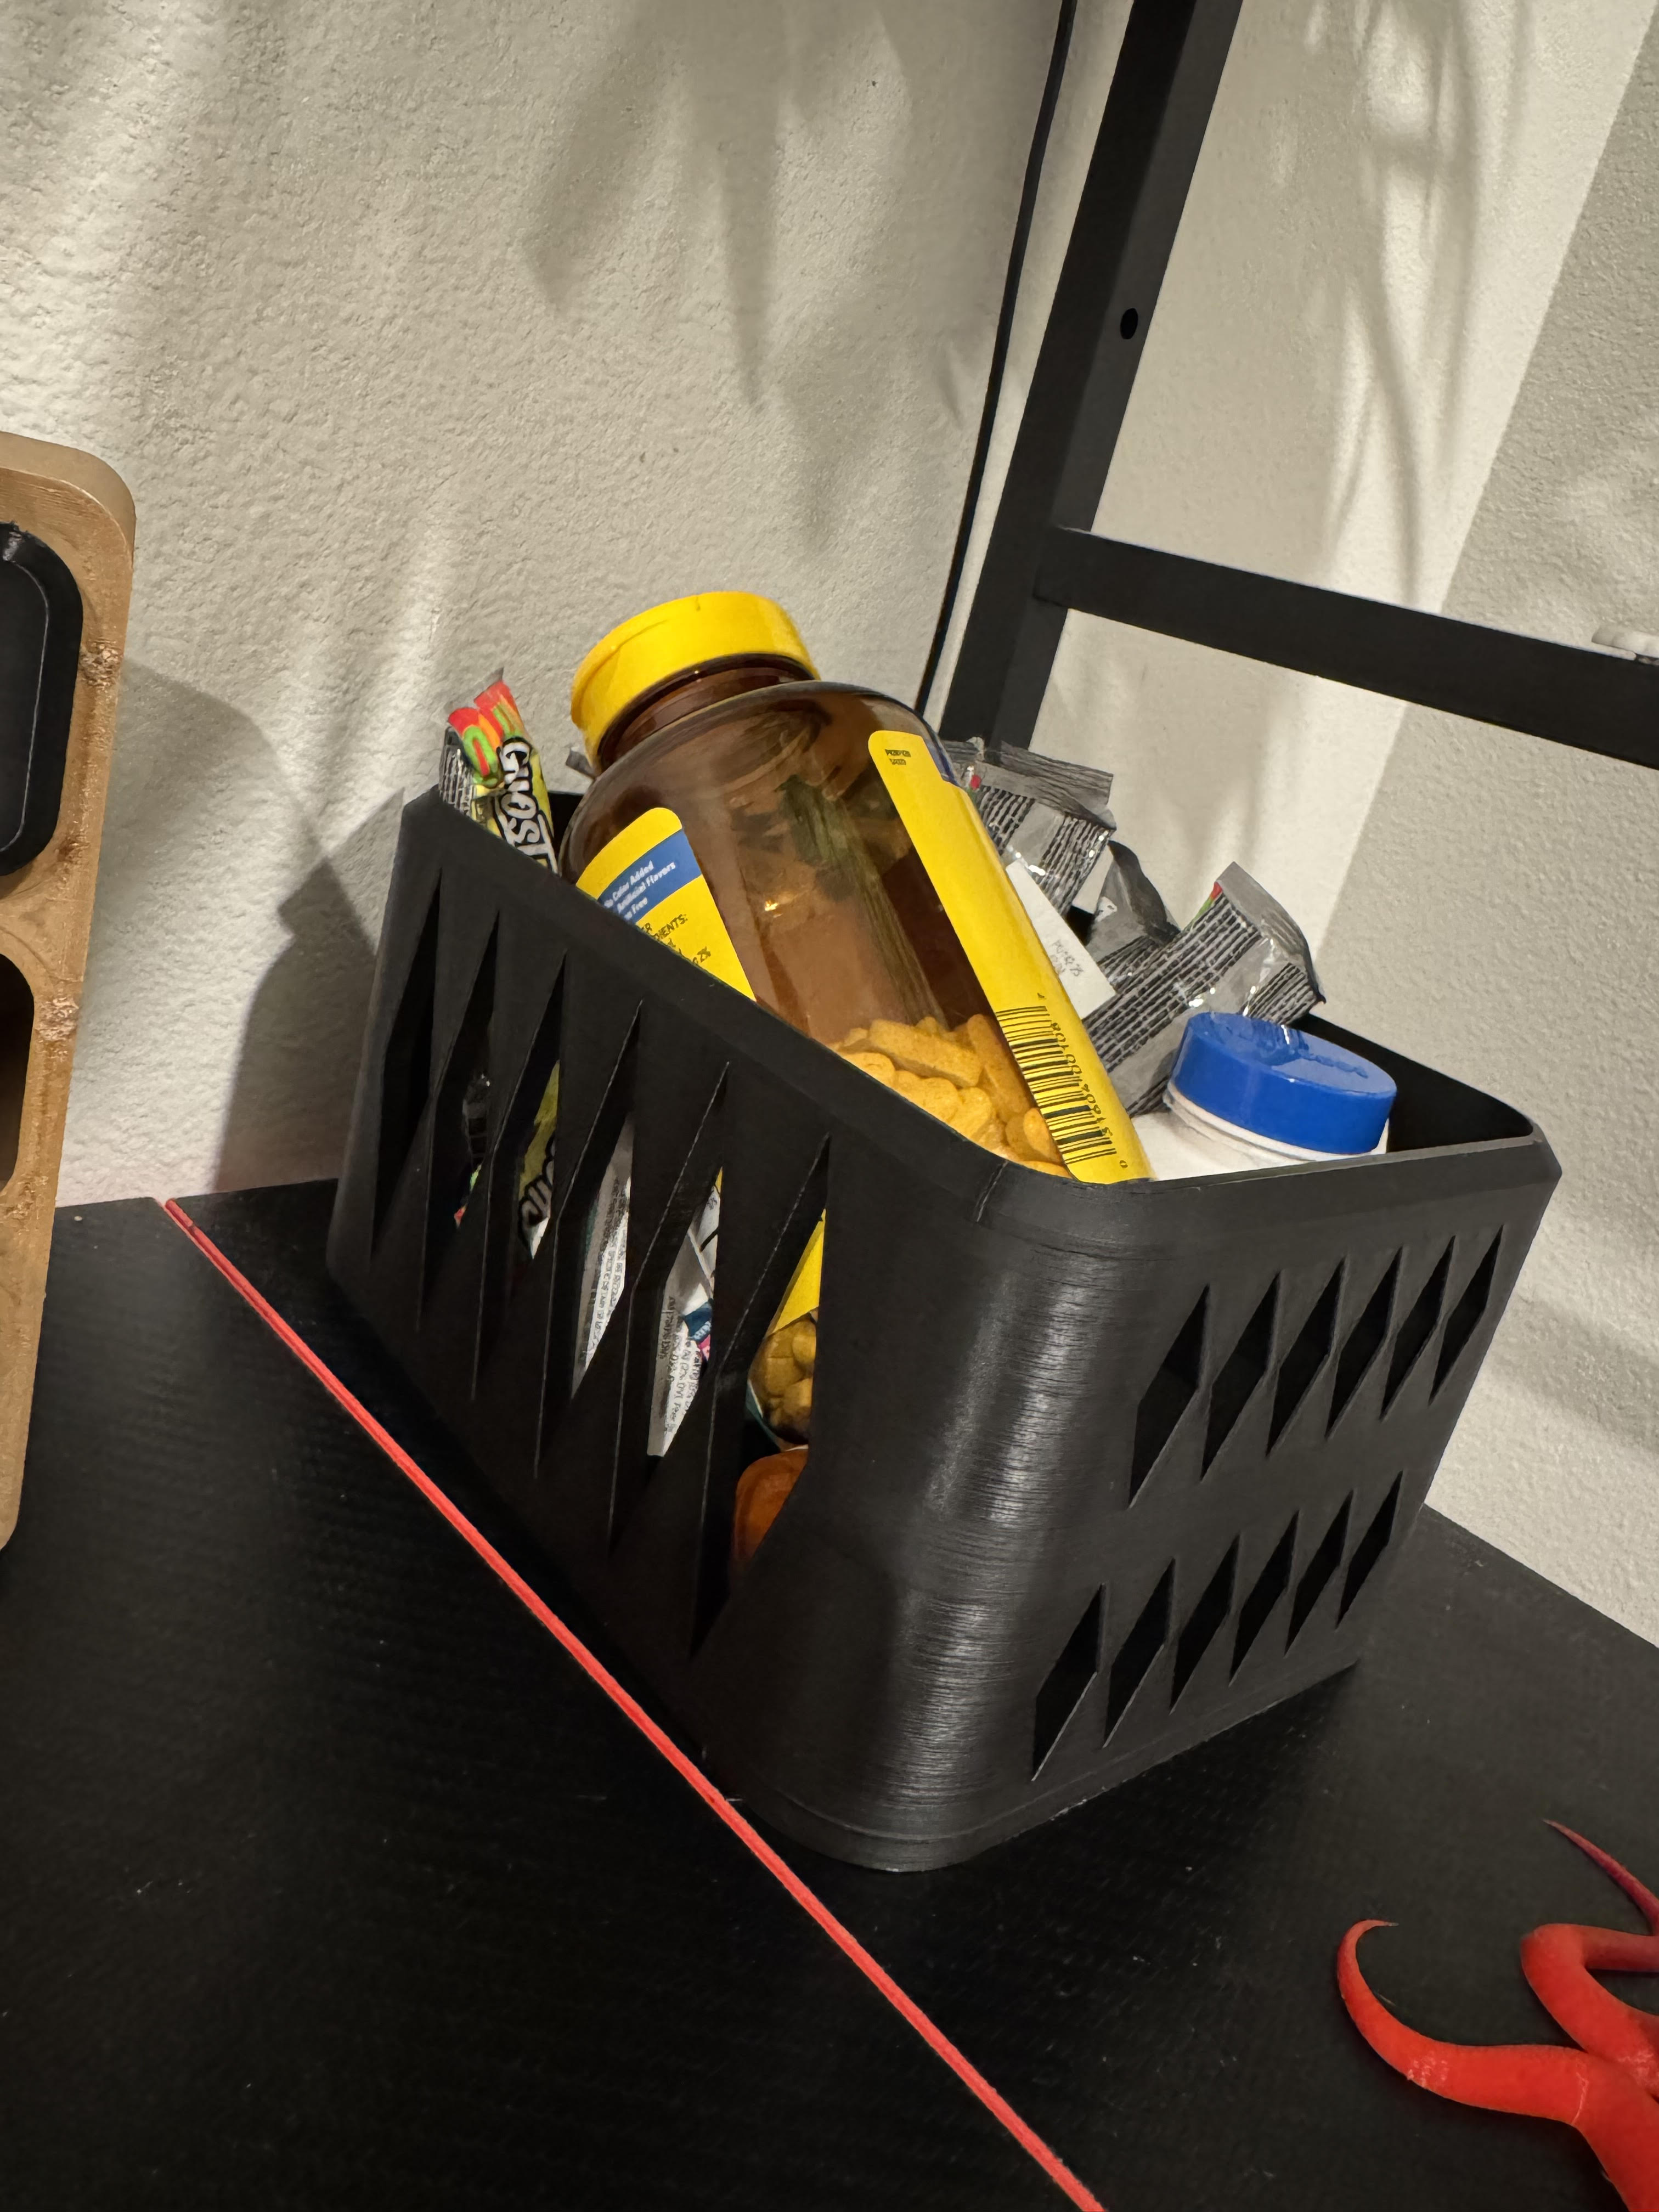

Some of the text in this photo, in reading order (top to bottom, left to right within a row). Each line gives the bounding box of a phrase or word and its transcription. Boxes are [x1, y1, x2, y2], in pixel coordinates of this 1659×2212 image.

[498, 738, 559, 874] GHOST
[630, 860, 654, 885] Added
[646, 862, 676, 887] Flavors
[631, 897, 648, 914] Free
[1119, 1159, 1128, 1169] 0
